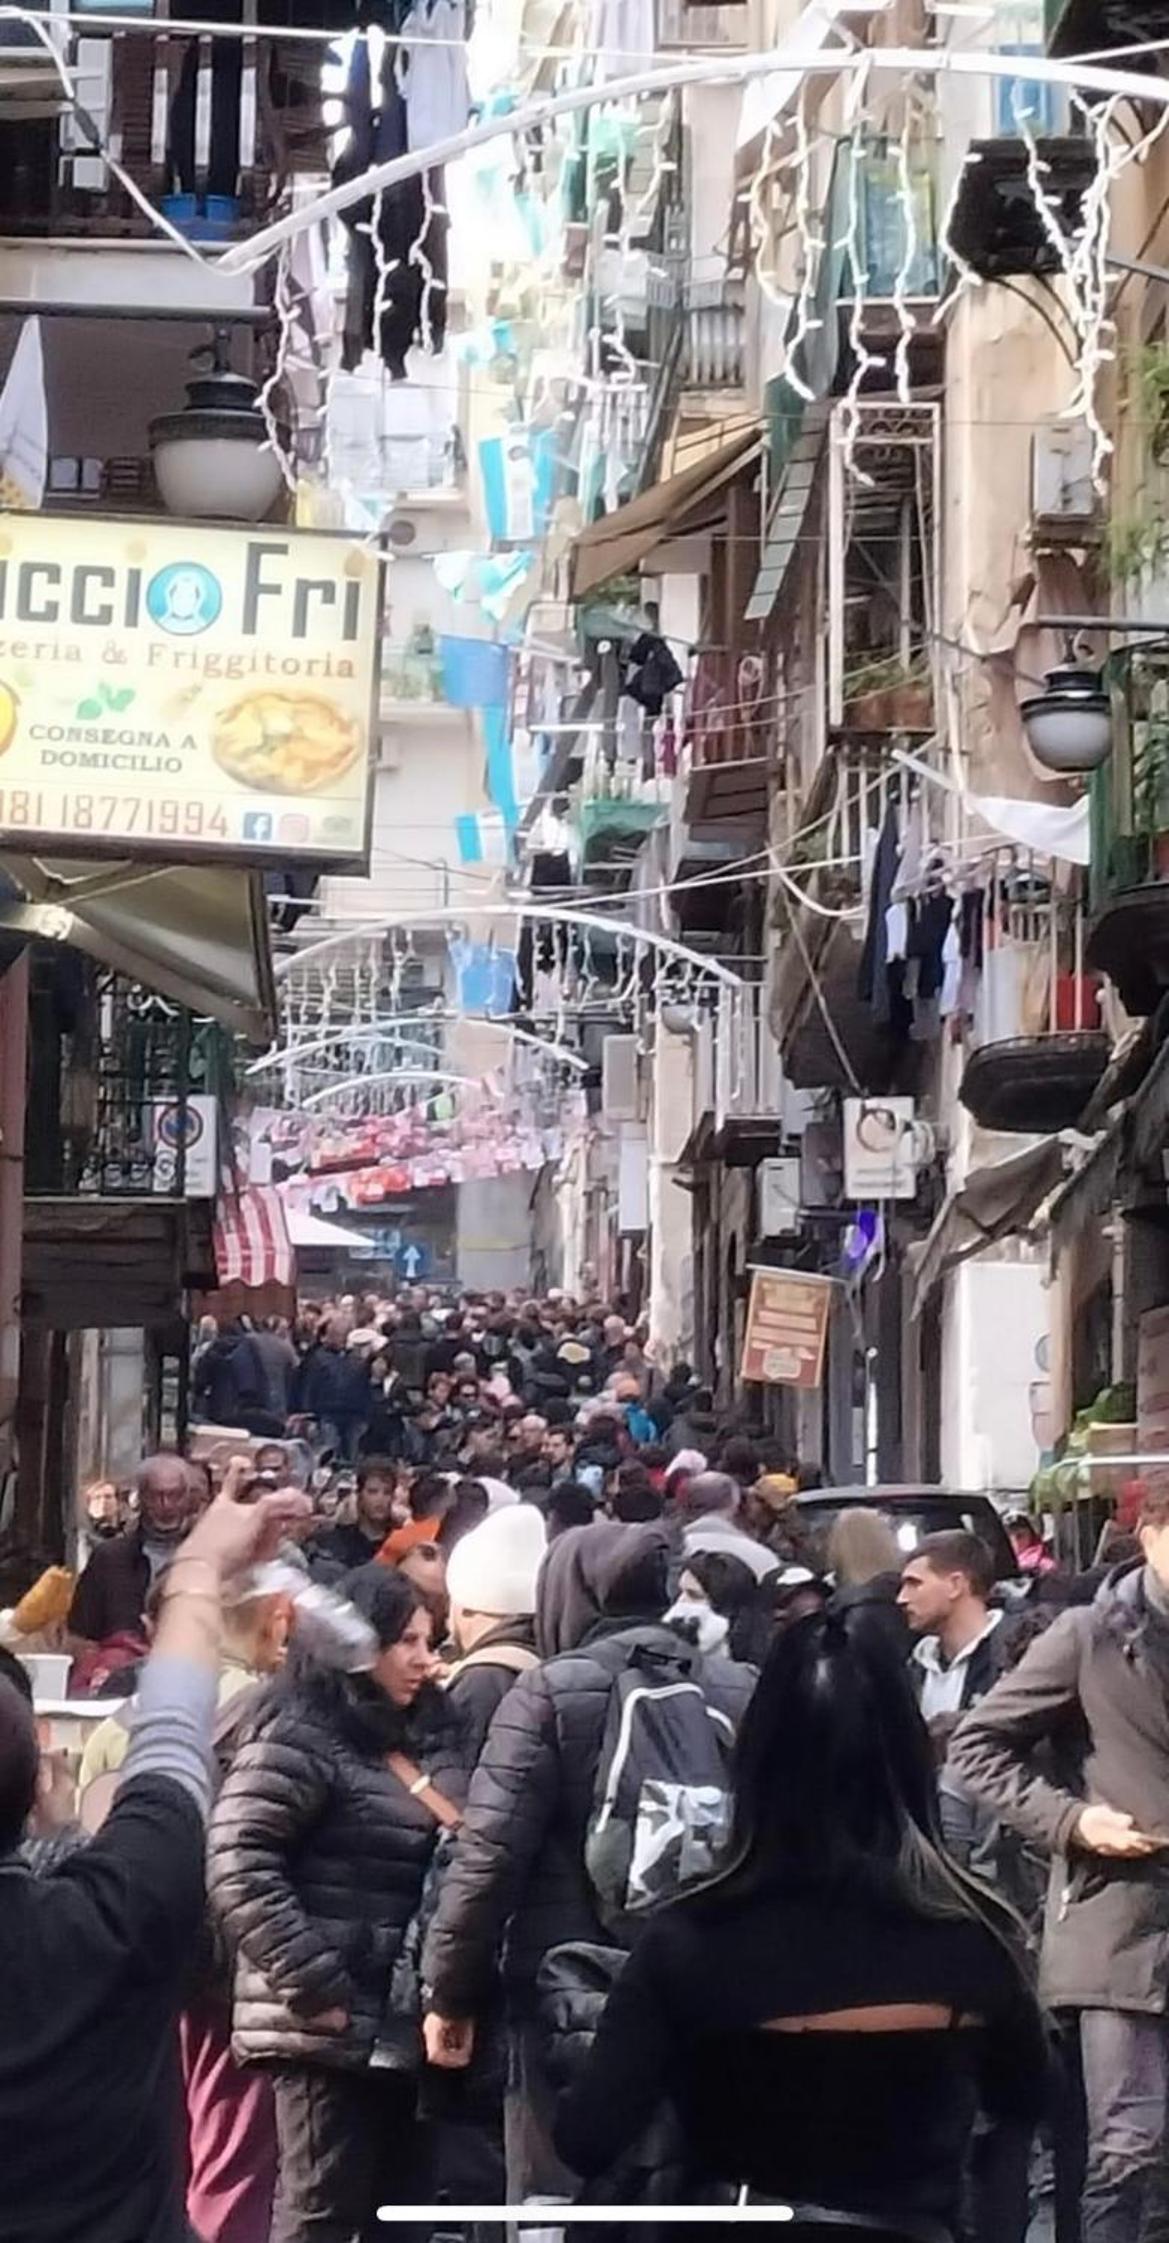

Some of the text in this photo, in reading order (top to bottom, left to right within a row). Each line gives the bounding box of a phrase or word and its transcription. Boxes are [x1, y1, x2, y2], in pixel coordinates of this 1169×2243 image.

[242, 541, 361, 641] Fri
[101, 640, 128, 665] &
[147, 642, 357, 680] Friggitoria
[28, 723, 198, 750] CONSEGNA A
[40, 749, 183, 773] DOMICILIO
[61, 793, 229, 837] 18771994
